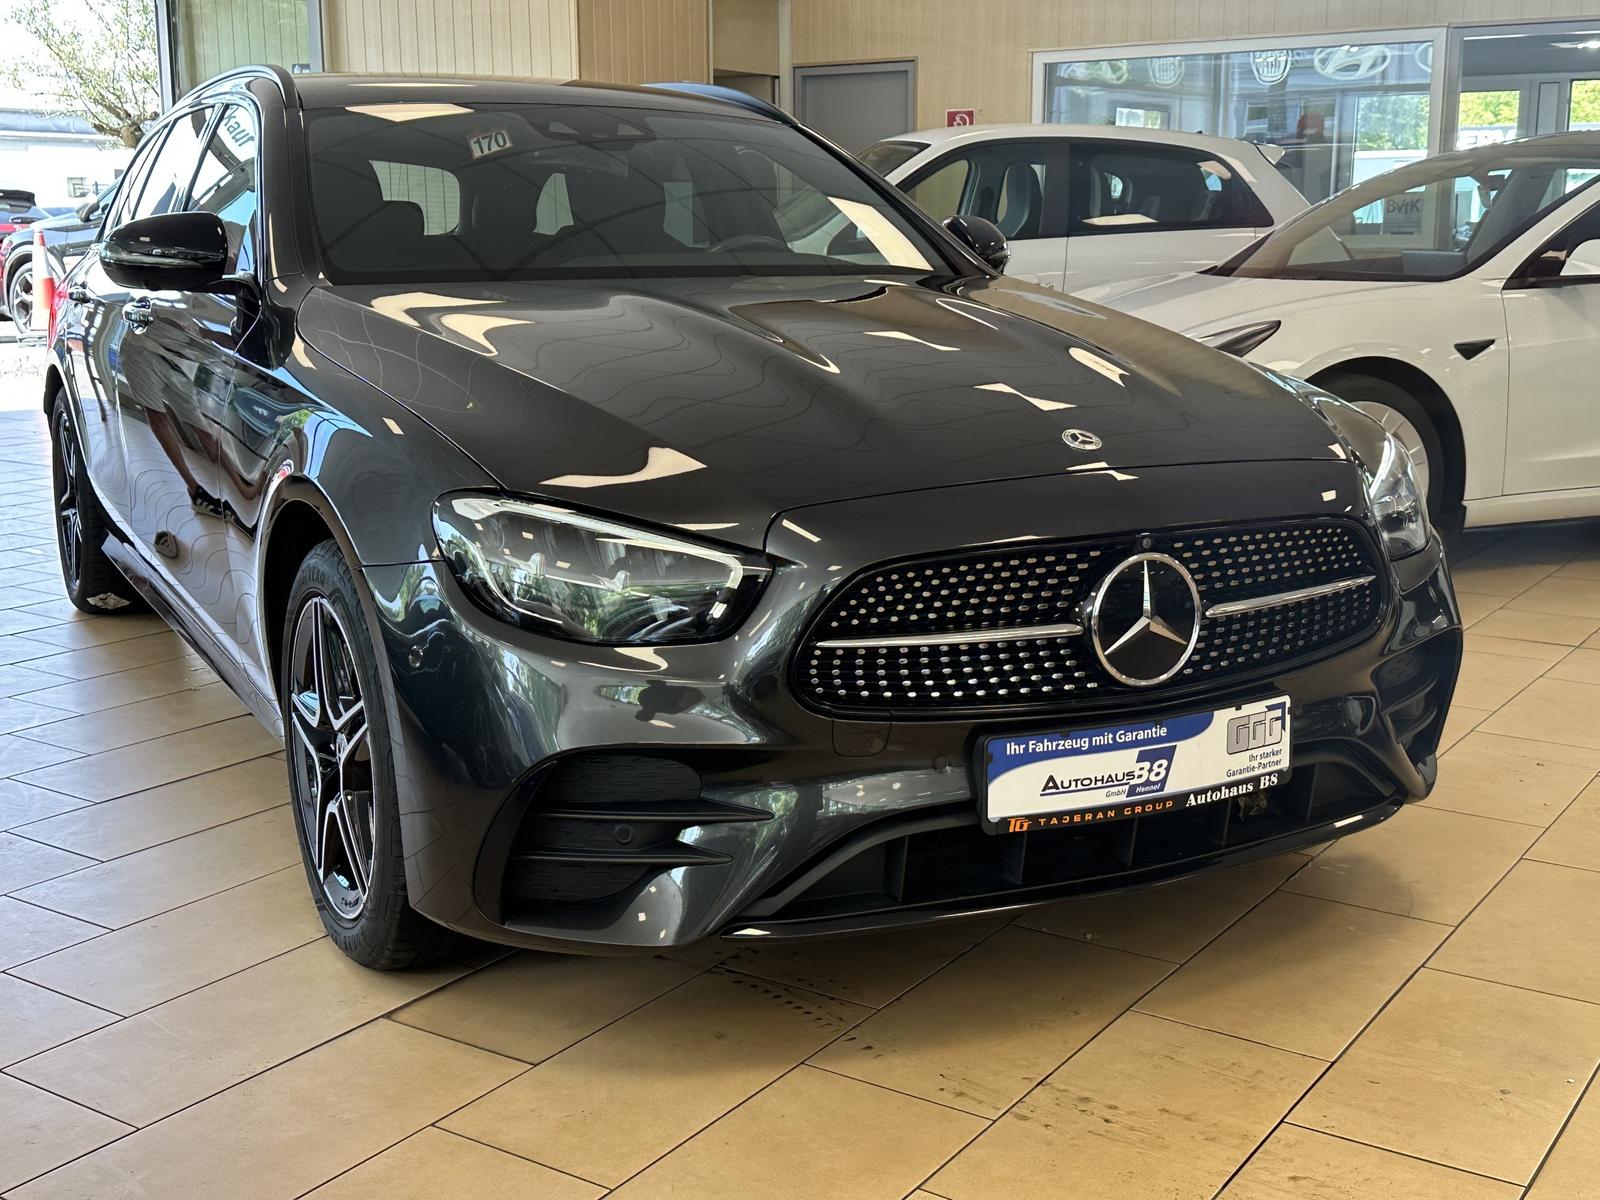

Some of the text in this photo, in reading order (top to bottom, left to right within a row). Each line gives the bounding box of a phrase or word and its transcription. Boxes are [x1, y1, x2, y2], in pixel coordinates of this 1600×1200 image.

[473, 131, 507, 154] 170
[1006, 725, 1167, 755] Ihr Fahrzeug mit Garantie
[1249, 748, 1282, 762] Ihr starker
[1226, 758, 1282, 778] Garantie-Partner
[1105, 788, 1126, 798] GmbH
[1186, 773, 1278, 807] Autohaus B8
[1038, 810, 1116, 826] TAJERAN
[1124, 800, 1174, 815] GROUP
